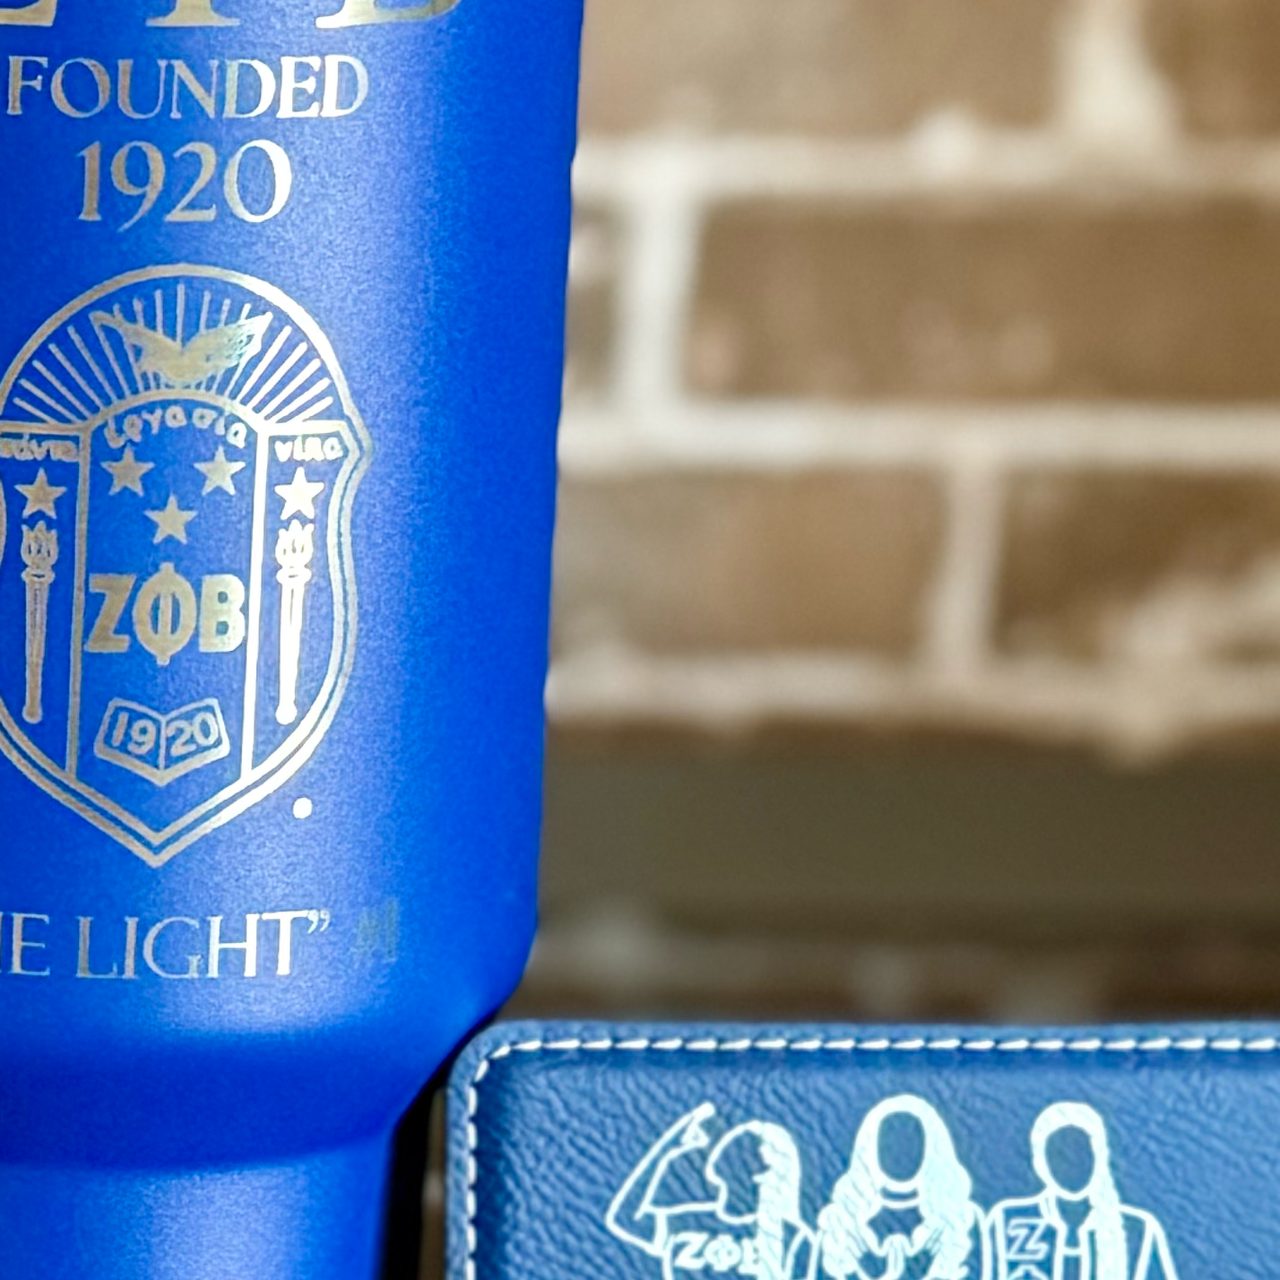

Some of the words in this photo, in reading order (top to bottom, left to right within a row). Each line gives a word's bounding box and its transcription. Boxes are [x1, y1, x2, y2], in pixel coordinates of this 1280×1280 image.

[5, 54, 369, 120] FOUNDED
[77, 139, 293, 233] 1920
[83, 561, 248, 666] ΖΦΒ
[107, 708, 222, 757] 1920
